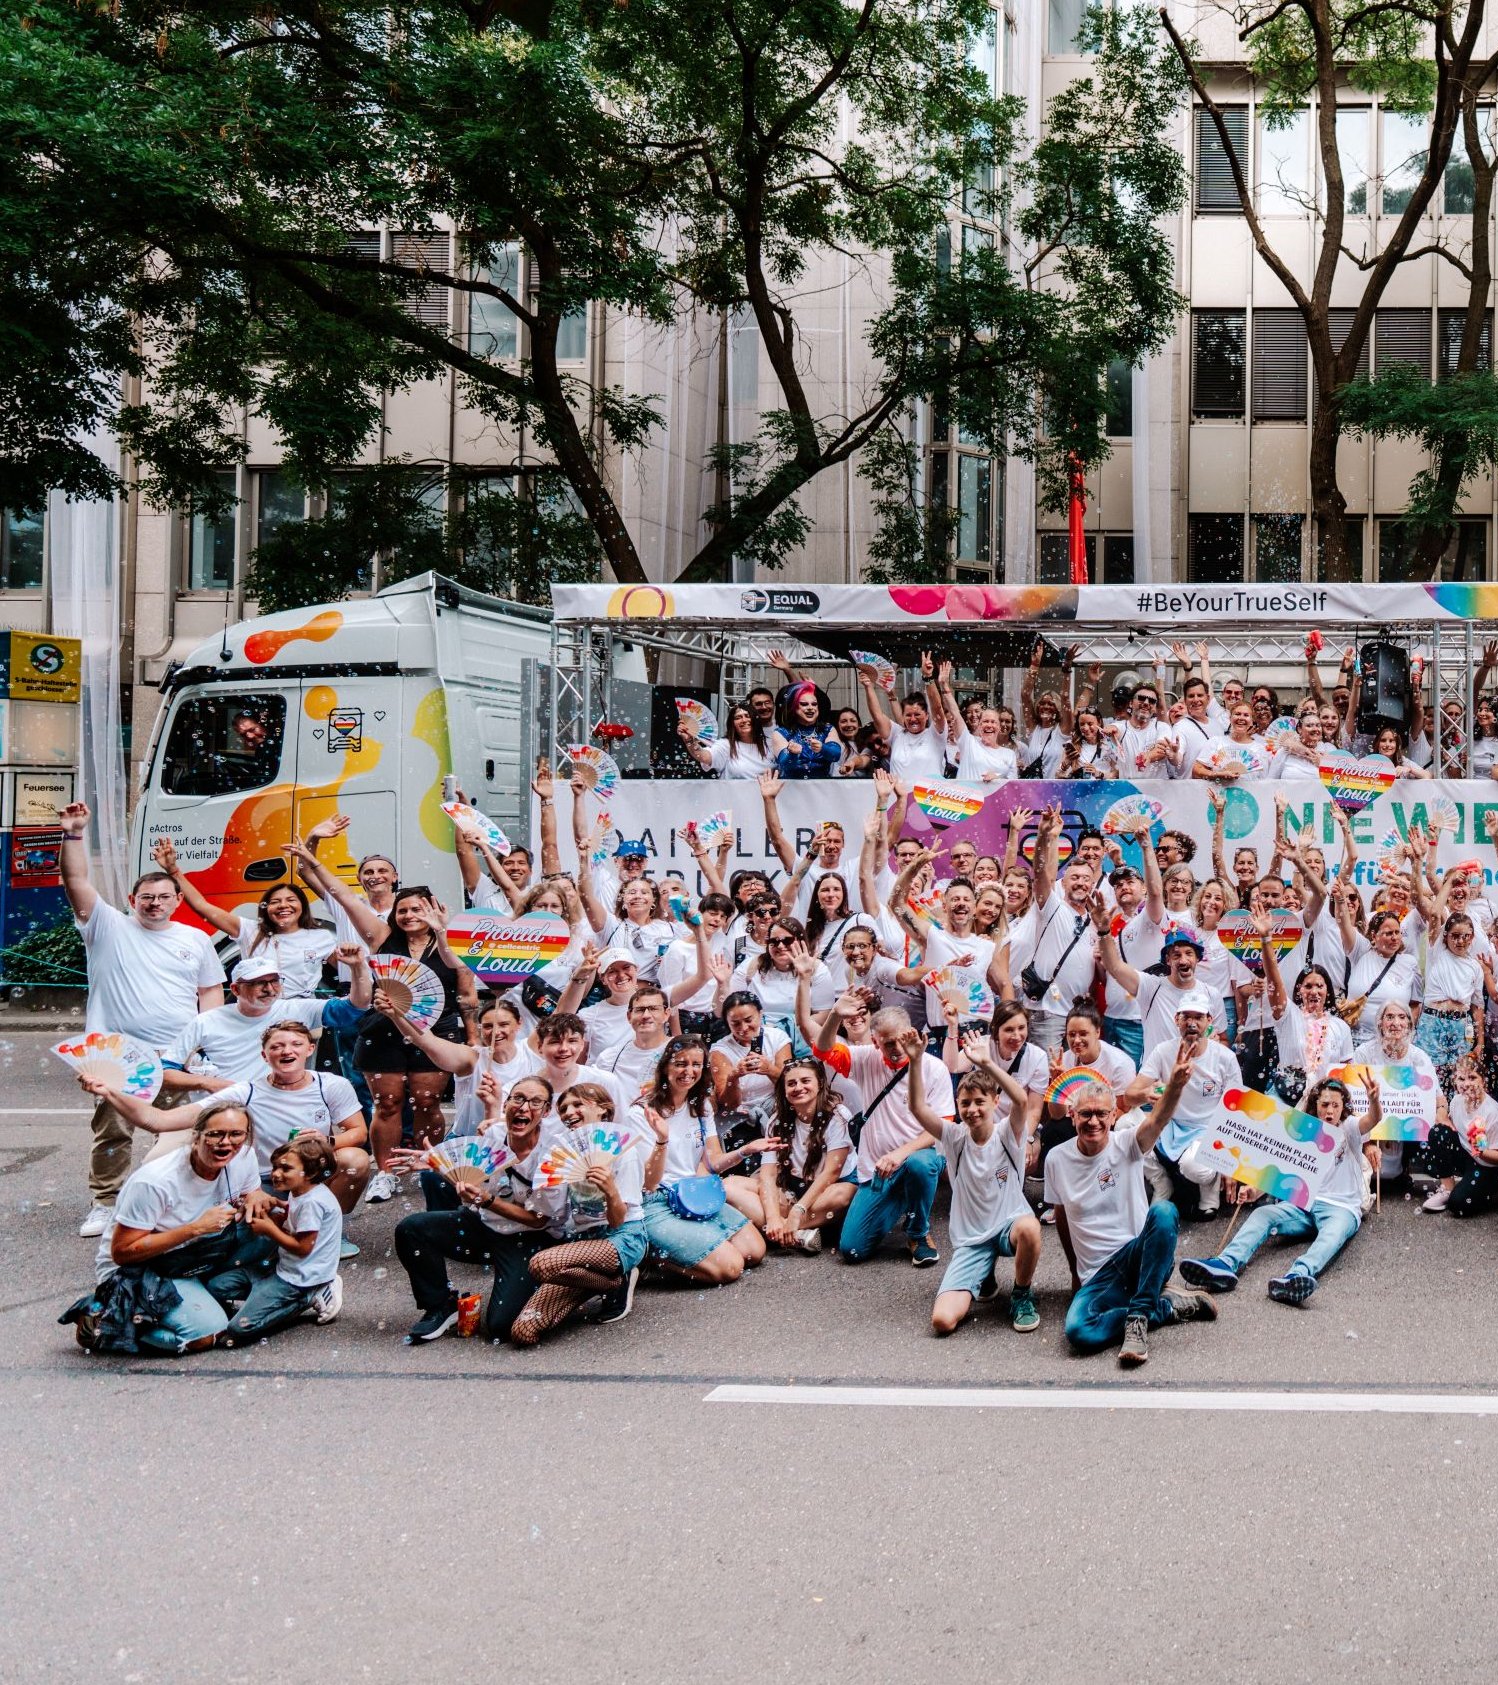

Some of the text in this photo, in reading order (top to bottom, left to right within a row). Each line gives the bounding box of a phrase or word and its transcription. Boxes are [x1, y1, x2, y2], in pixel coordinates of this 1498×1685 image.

[773, 595, 813, 605] EQUAL
[1137, 592, 1327, 612] #BeYourTrueSelf
[1332, 759, 1384, 779] Proud
[23, 784, 65, 792] Feuersee
[1335, 784, 1374, 802] Loud
[927, 806, 963, 822] Loud
[149, 824, 183, 833] eActros
[174, 837, 188, 846] auf
[191, 836, 206, 846] der
[470, 919, 550, 943] Proud
[468, 940, 483, 955] &
[497, 943, 541, 951] cellcentric
[1234, 936, 1244, 948] &
[476, 950, 540, 973] Loud
[1216, 1125, 1319, 1174] AUF UNSERER LADEFLÄCHE
[1225, 1119, 1317, 1164] HASS HAT KEINEN PLATZ
